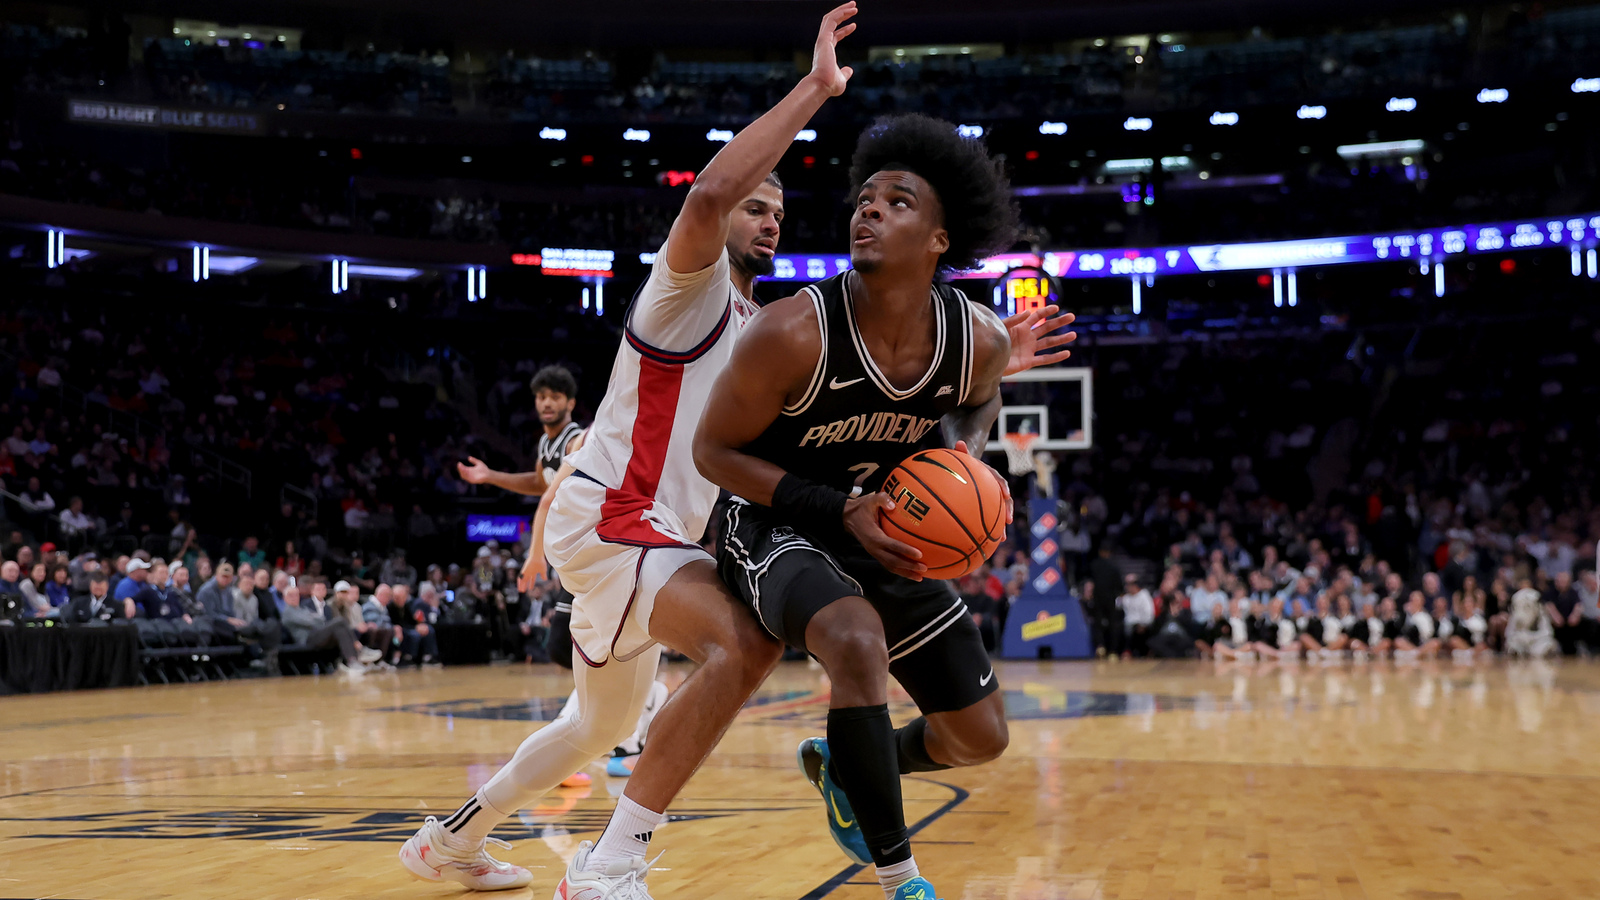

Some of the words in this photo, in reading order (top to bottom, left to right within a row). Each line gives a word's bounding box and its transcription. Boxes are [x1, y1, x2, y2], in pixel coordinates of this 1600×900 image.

[73, 104, 107, 120] BUD
[109, 105, 156, 123] LIGHT
[161, 109, 203, 127] BLUE
[798, 412, 940, 448] PROVIDENC
[883, 474, 931, 522] ELITE
